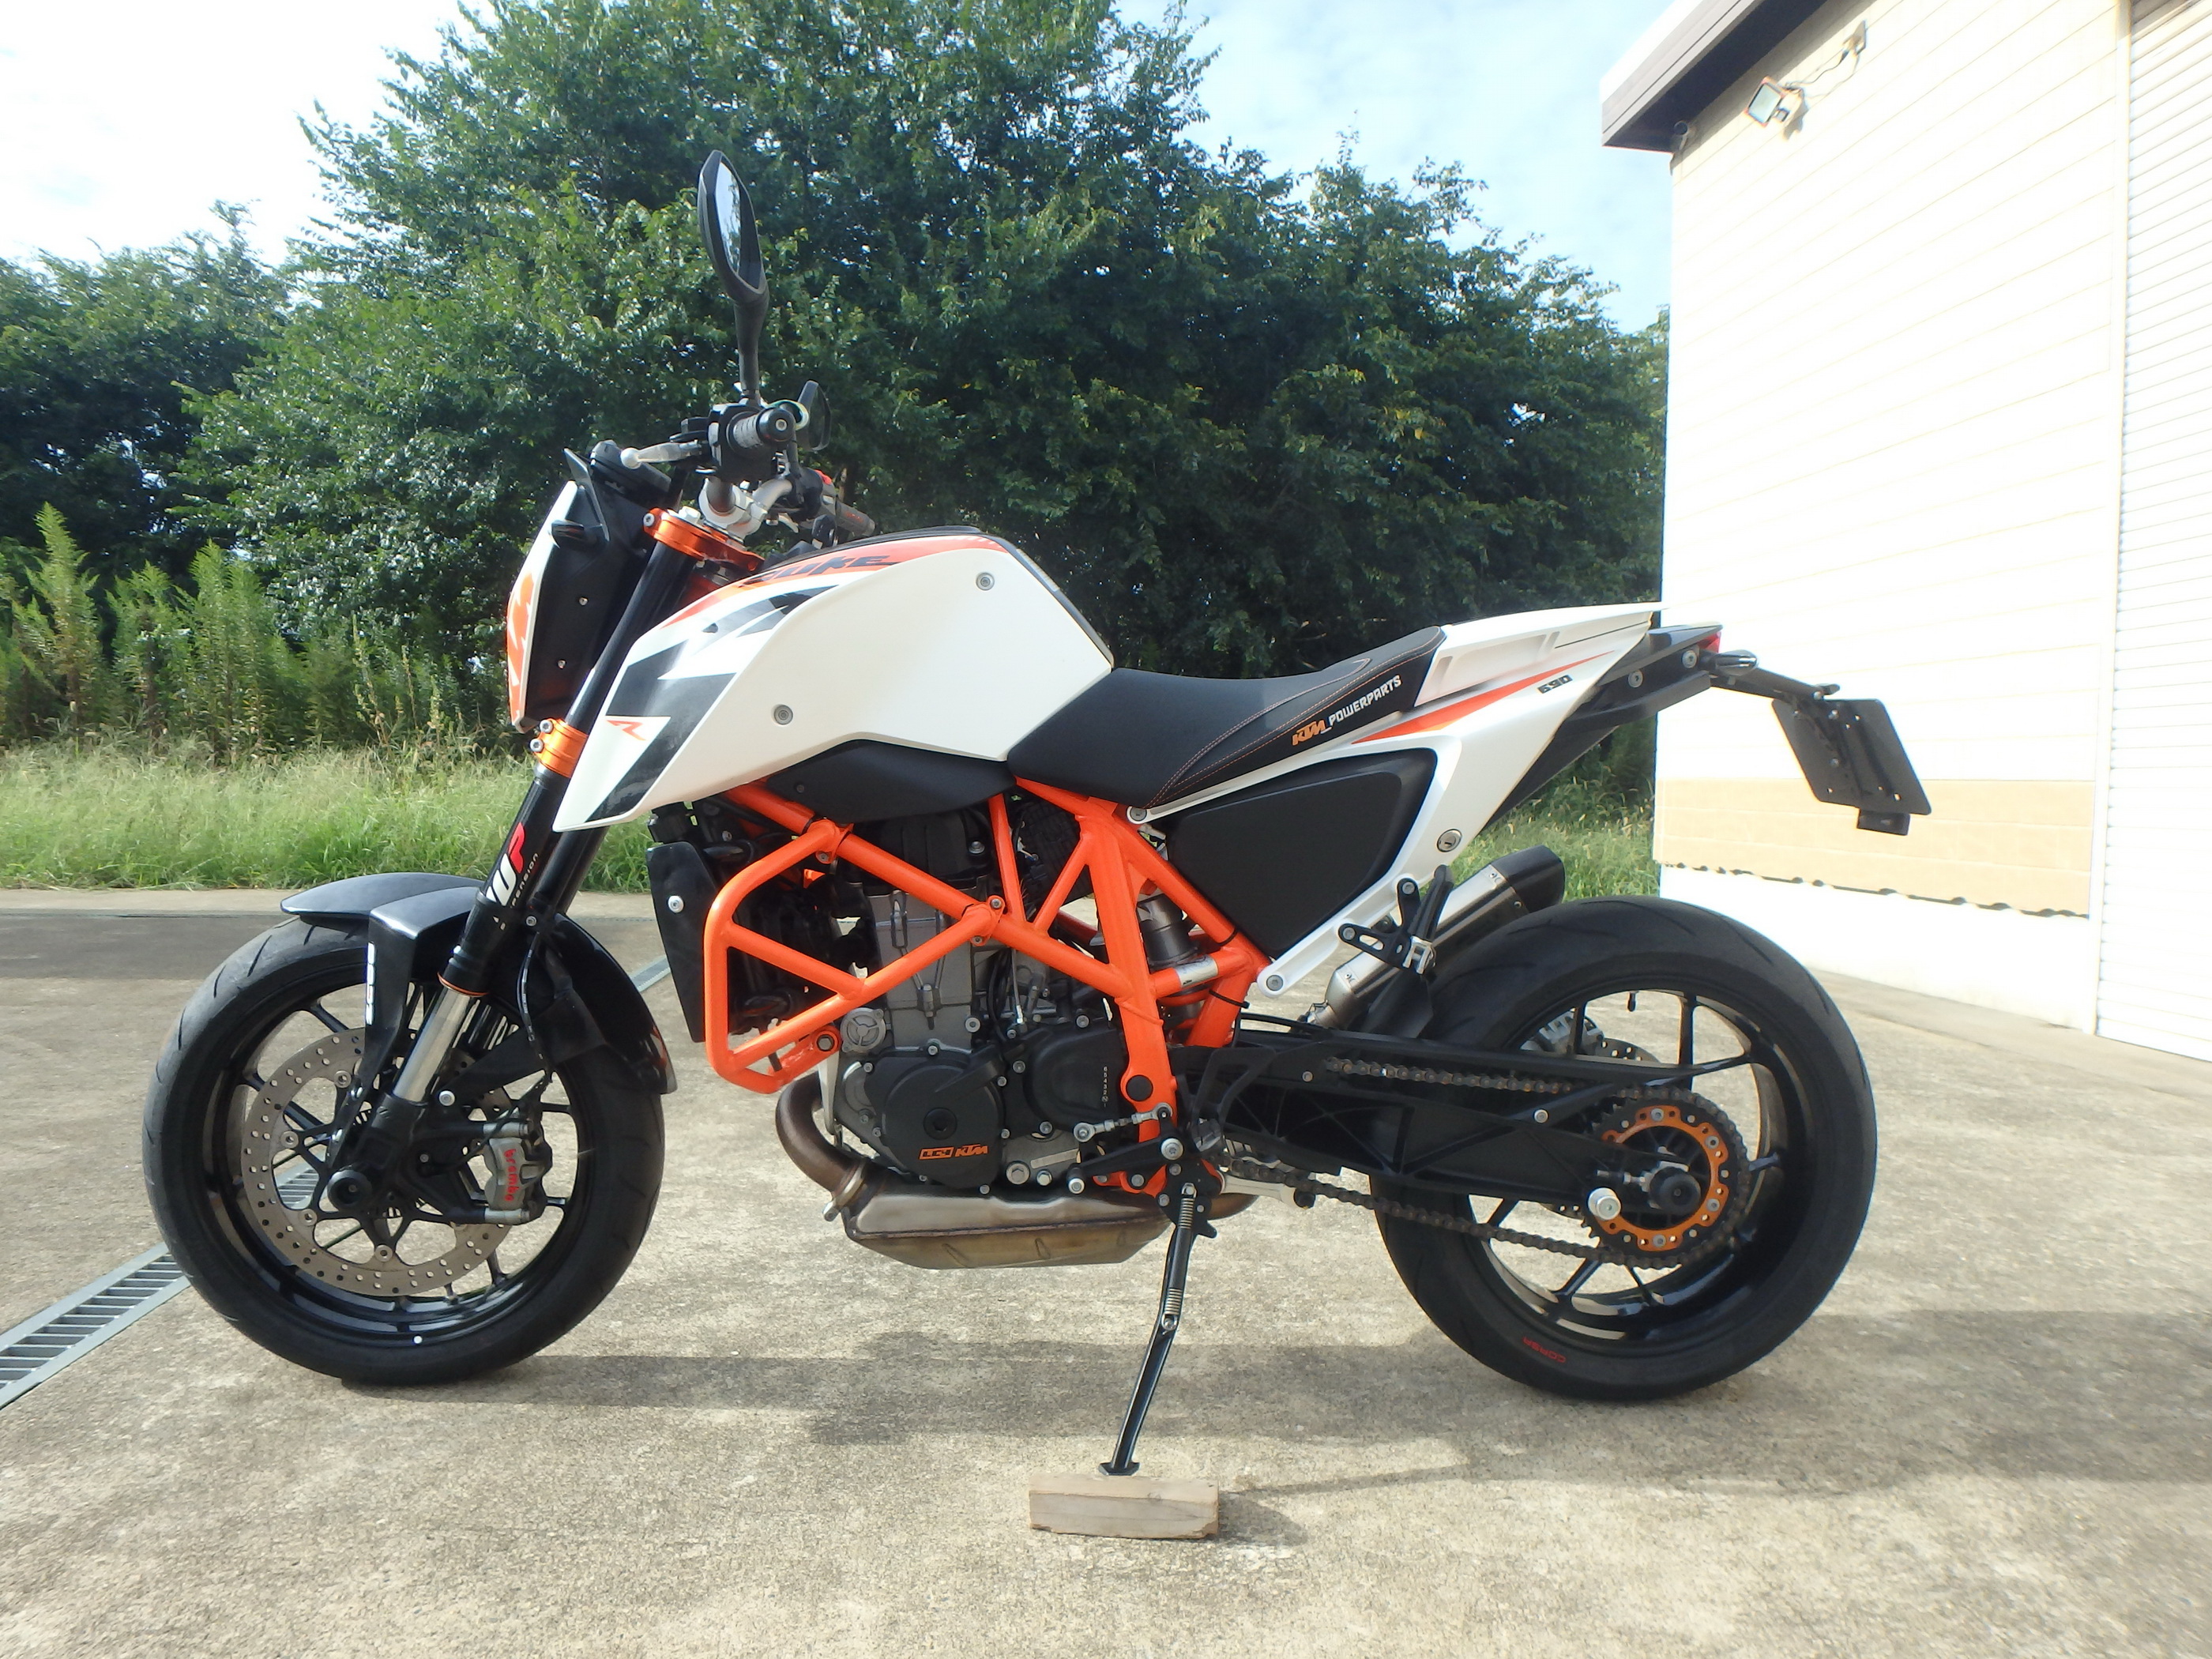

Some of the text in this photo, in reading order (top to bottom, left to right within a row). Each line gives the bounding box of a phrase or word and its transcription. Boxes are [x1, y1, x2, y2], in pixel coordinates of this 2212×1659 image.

[1537, 675, 1574, 694] 690
[955, 1144, 988, 1157] KTM
[503, 1149, 520, 1202] brembo
